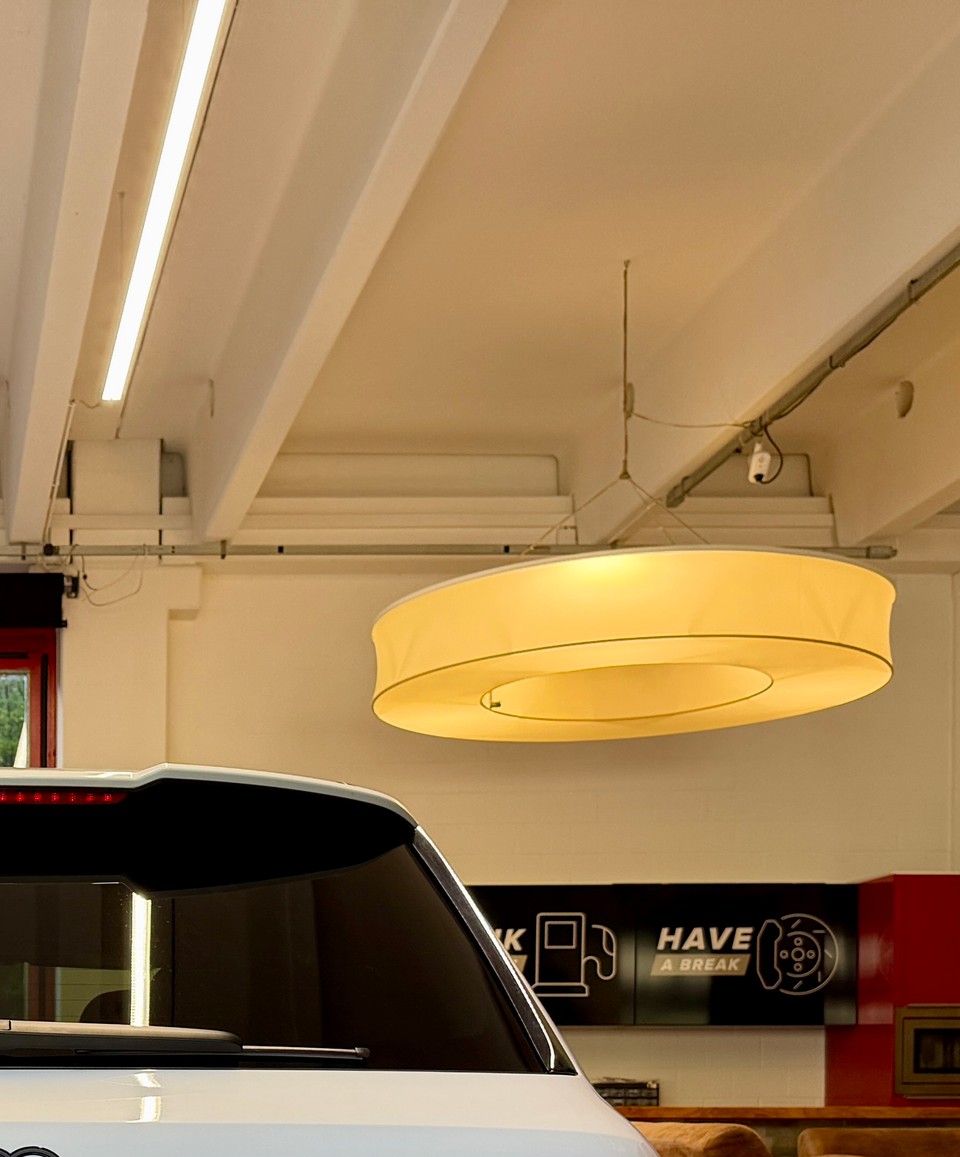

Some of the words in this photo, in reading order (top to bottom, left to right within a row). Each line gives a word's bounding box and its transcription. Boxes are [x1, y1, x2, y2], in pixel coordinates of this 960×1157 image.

[494, 928, 527, 951] K
[657, 927, 754, 950] HAVE
[660, 958, 673, 971] A
[680, 958, 740, 971] BREAK
